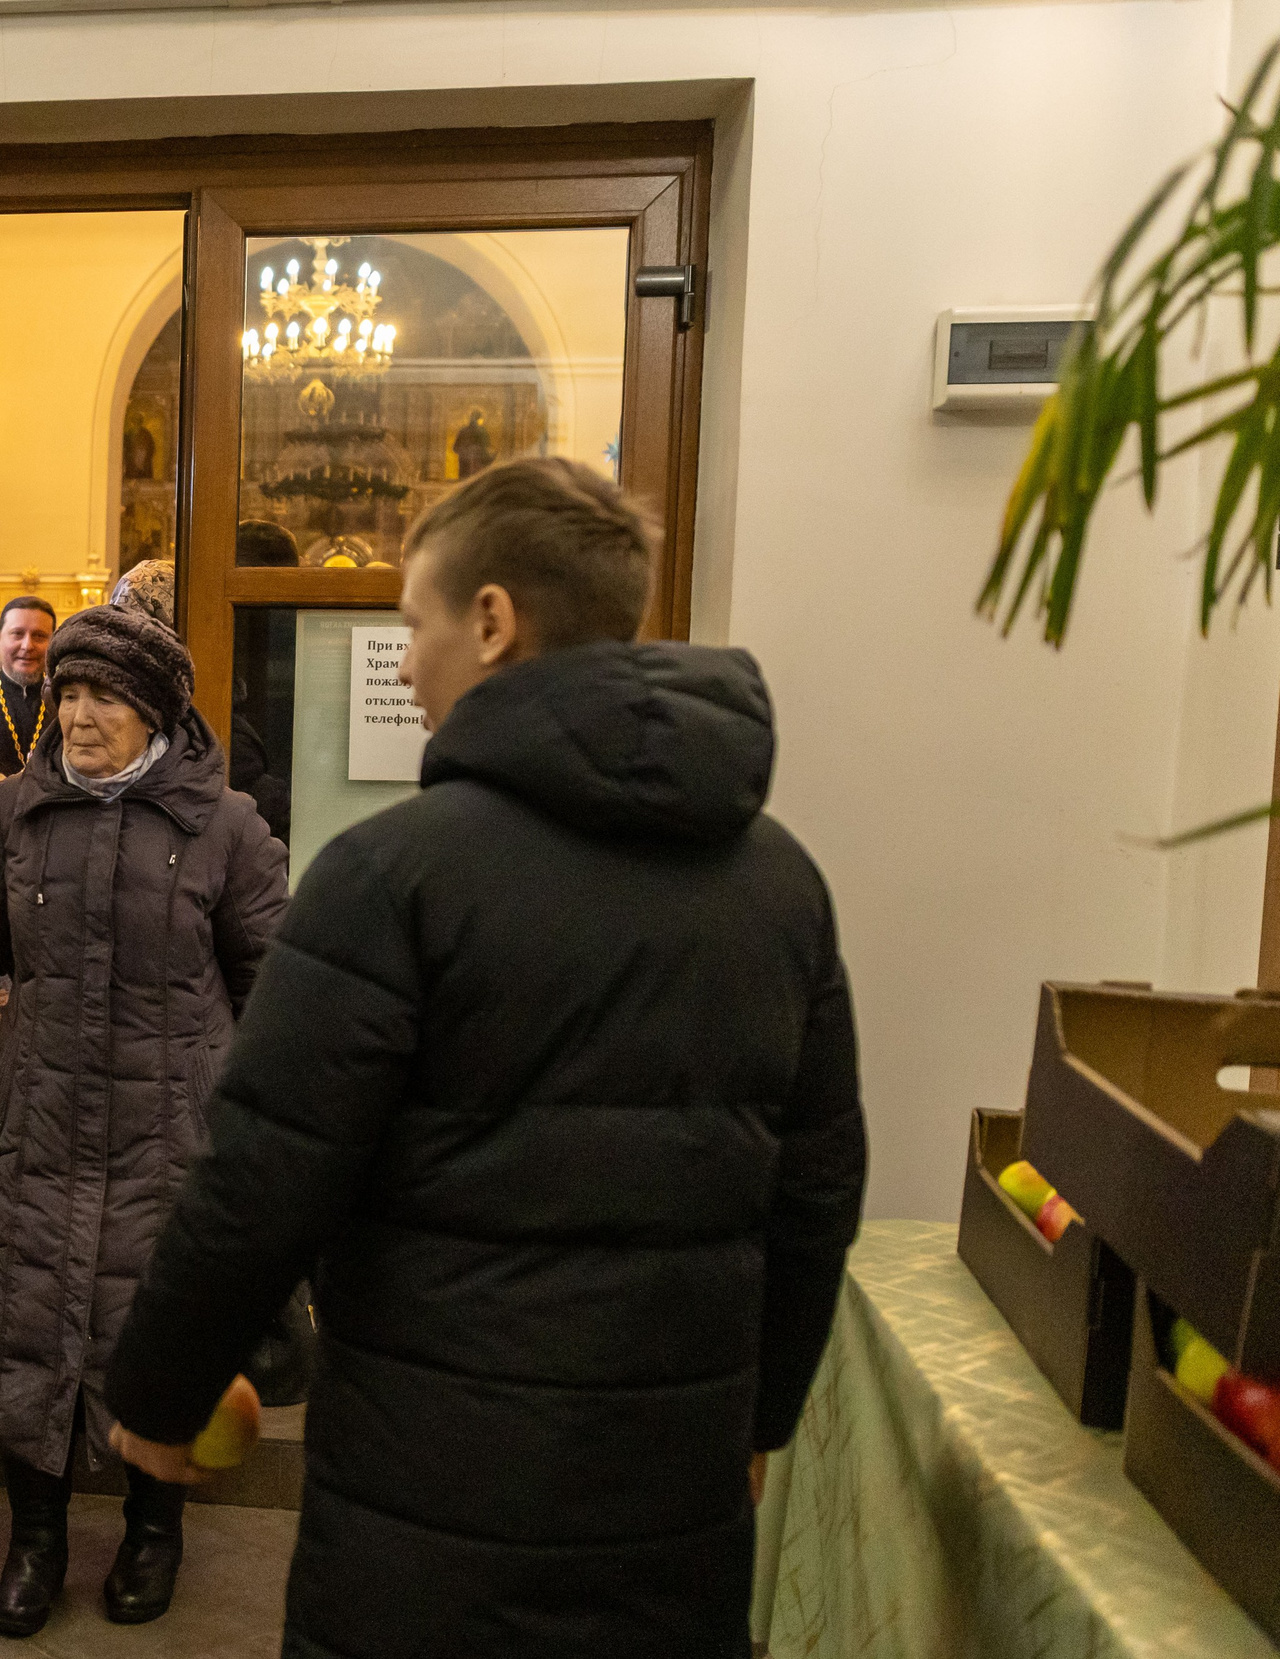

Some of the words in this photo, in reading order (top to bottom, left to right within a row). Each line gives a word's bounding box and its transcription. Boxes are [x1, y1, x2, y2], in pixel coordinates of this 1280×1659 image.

[367, 640, 393, 653] При
[365, 697, 414, 706] отключ
[364, 714, 424, 726] телефон!
